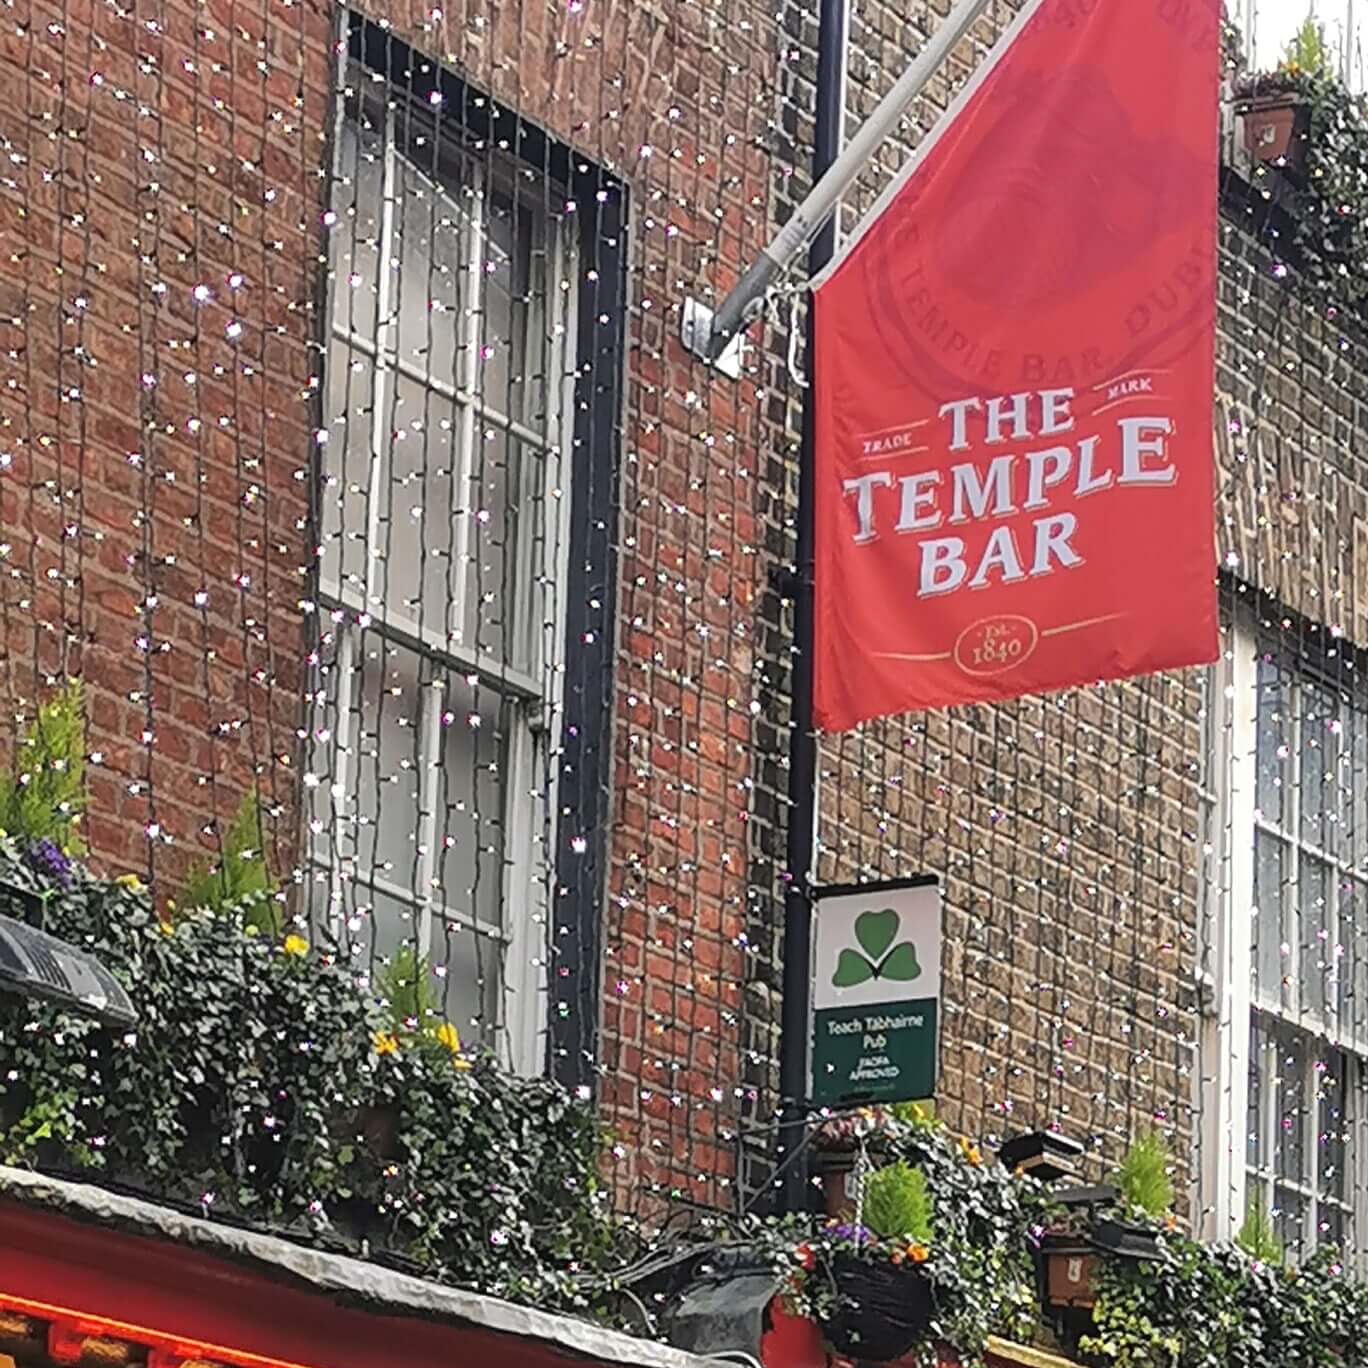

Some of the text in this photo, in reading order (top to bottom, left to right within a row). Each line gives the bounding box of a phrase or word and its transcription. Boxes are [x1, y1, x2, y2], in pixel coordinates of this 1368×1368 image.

[938, 386, 1075, 451] THE
[843, 416, 1177, 546] TEMPLE
[918, 516, 1086, 598] BAR
[973, 639, 1021, 665] 1840
